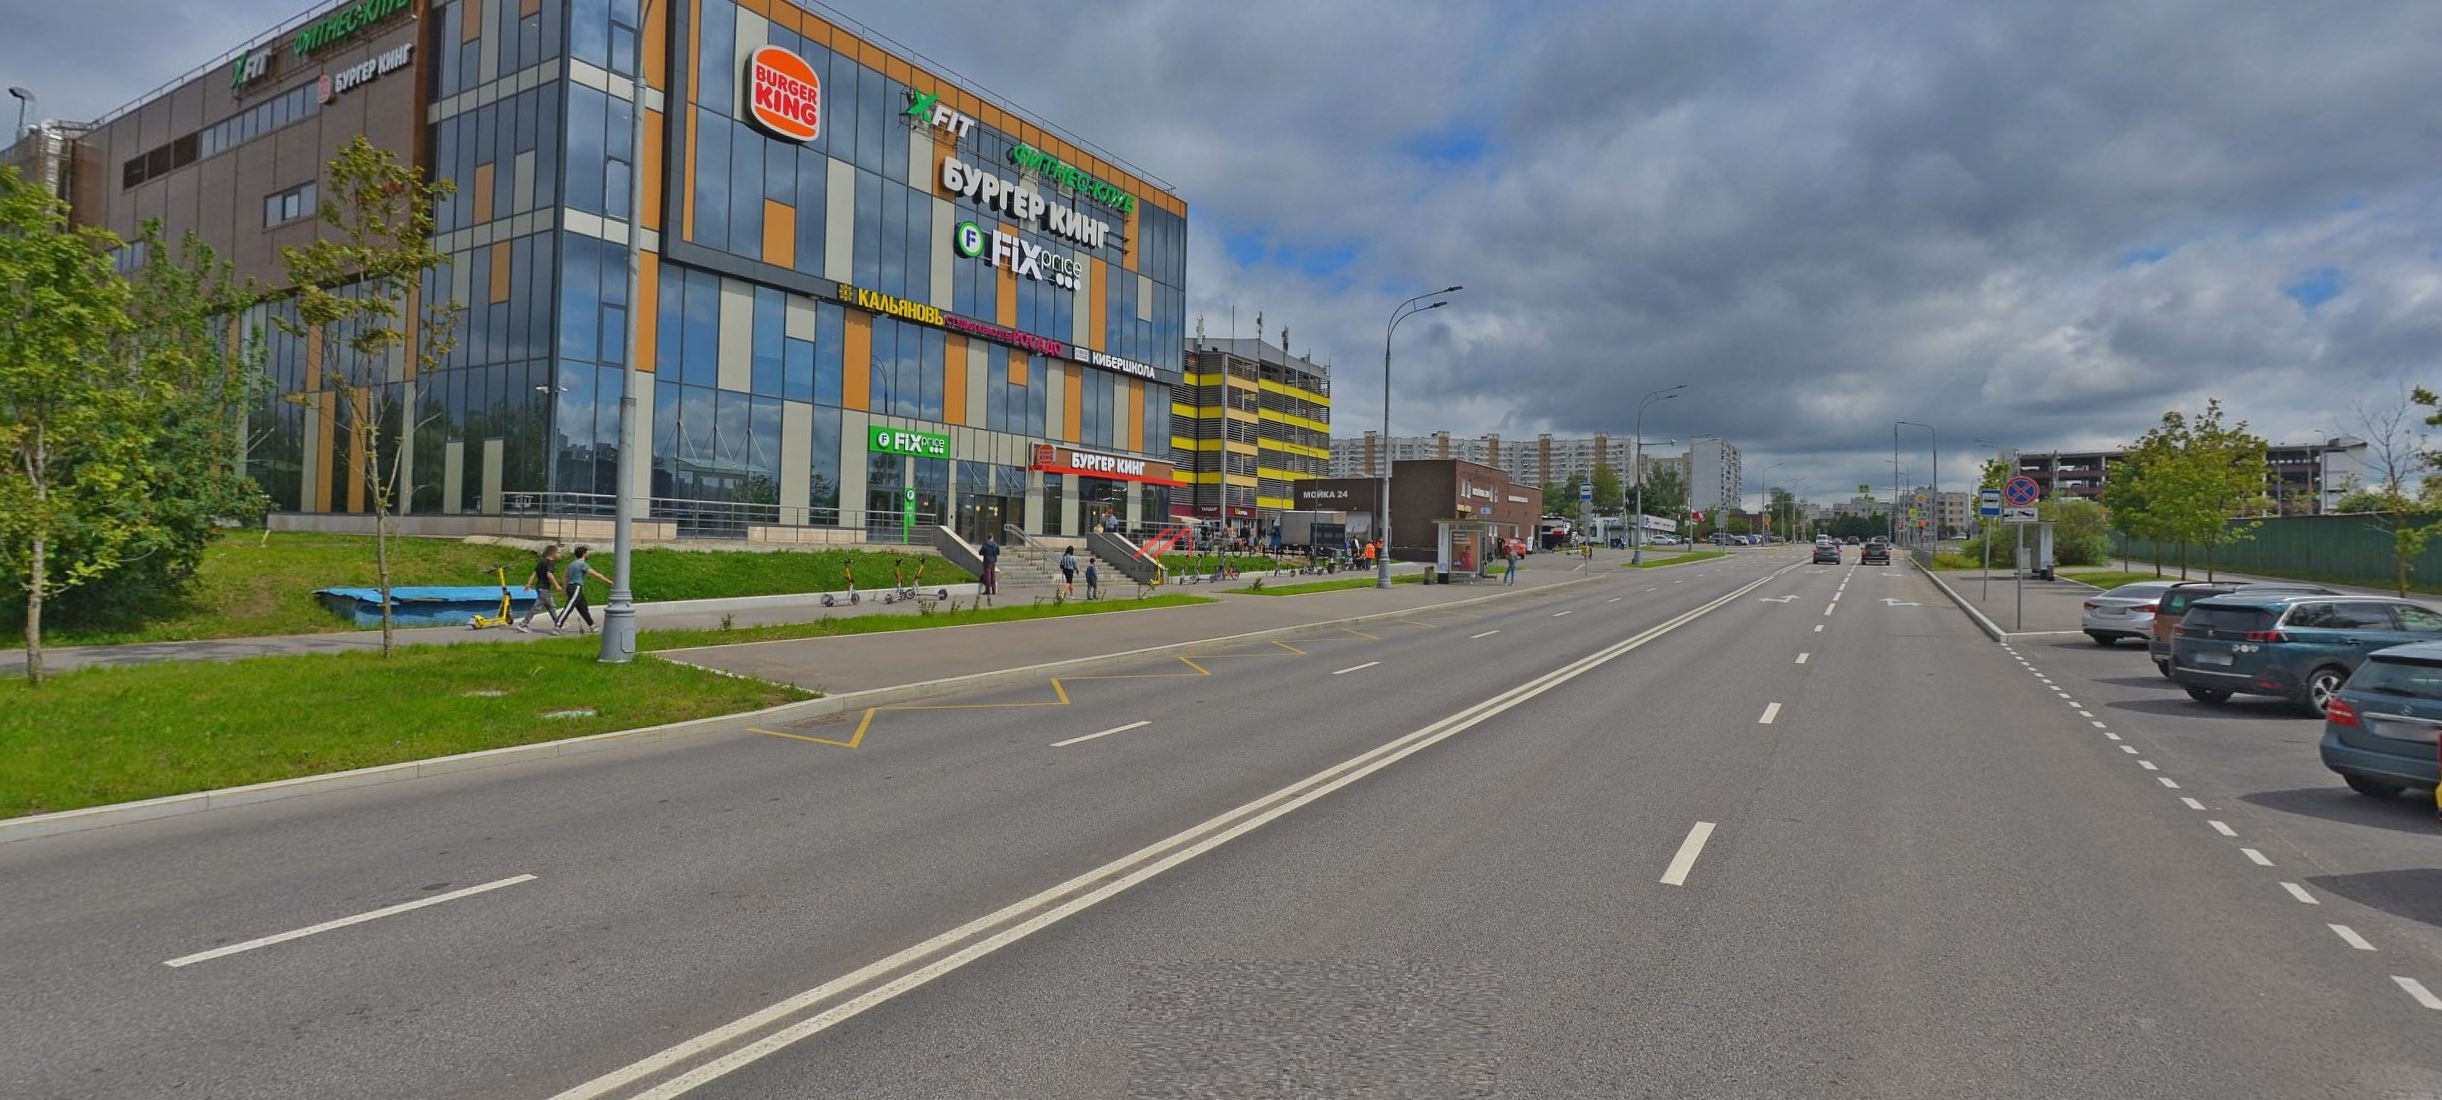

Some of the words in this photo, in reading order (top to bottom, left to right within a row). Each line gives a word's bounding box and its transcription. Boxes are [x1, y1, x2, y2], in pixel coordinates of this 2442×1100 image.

[334, 58, 376, 93] БУРГЕР
[378, 43, 413, 75] КИНГ
[756, 64, 817, 105] BURGER
[756, 82, 817, 126] KING
[1013, 143, 1135, 214] ФИТНЕС-КЛУБ
[944, 155, 1046, 222] БУРГЕР
[1050, 201, 1110, 249] КИНГ
[1041, 250, 1083, 278] price
[1092, 351, 1155, 379] КИБЕРШКОЛА
[922, 437, 945, 447] price
[1071, 452, 1115, 472] БУРГЕР
[1116, 458, 1145, 476] КИНГ
[1303, 489, 1335, 499] МОЙКА
[1337, 490, 1348, 498] 24
